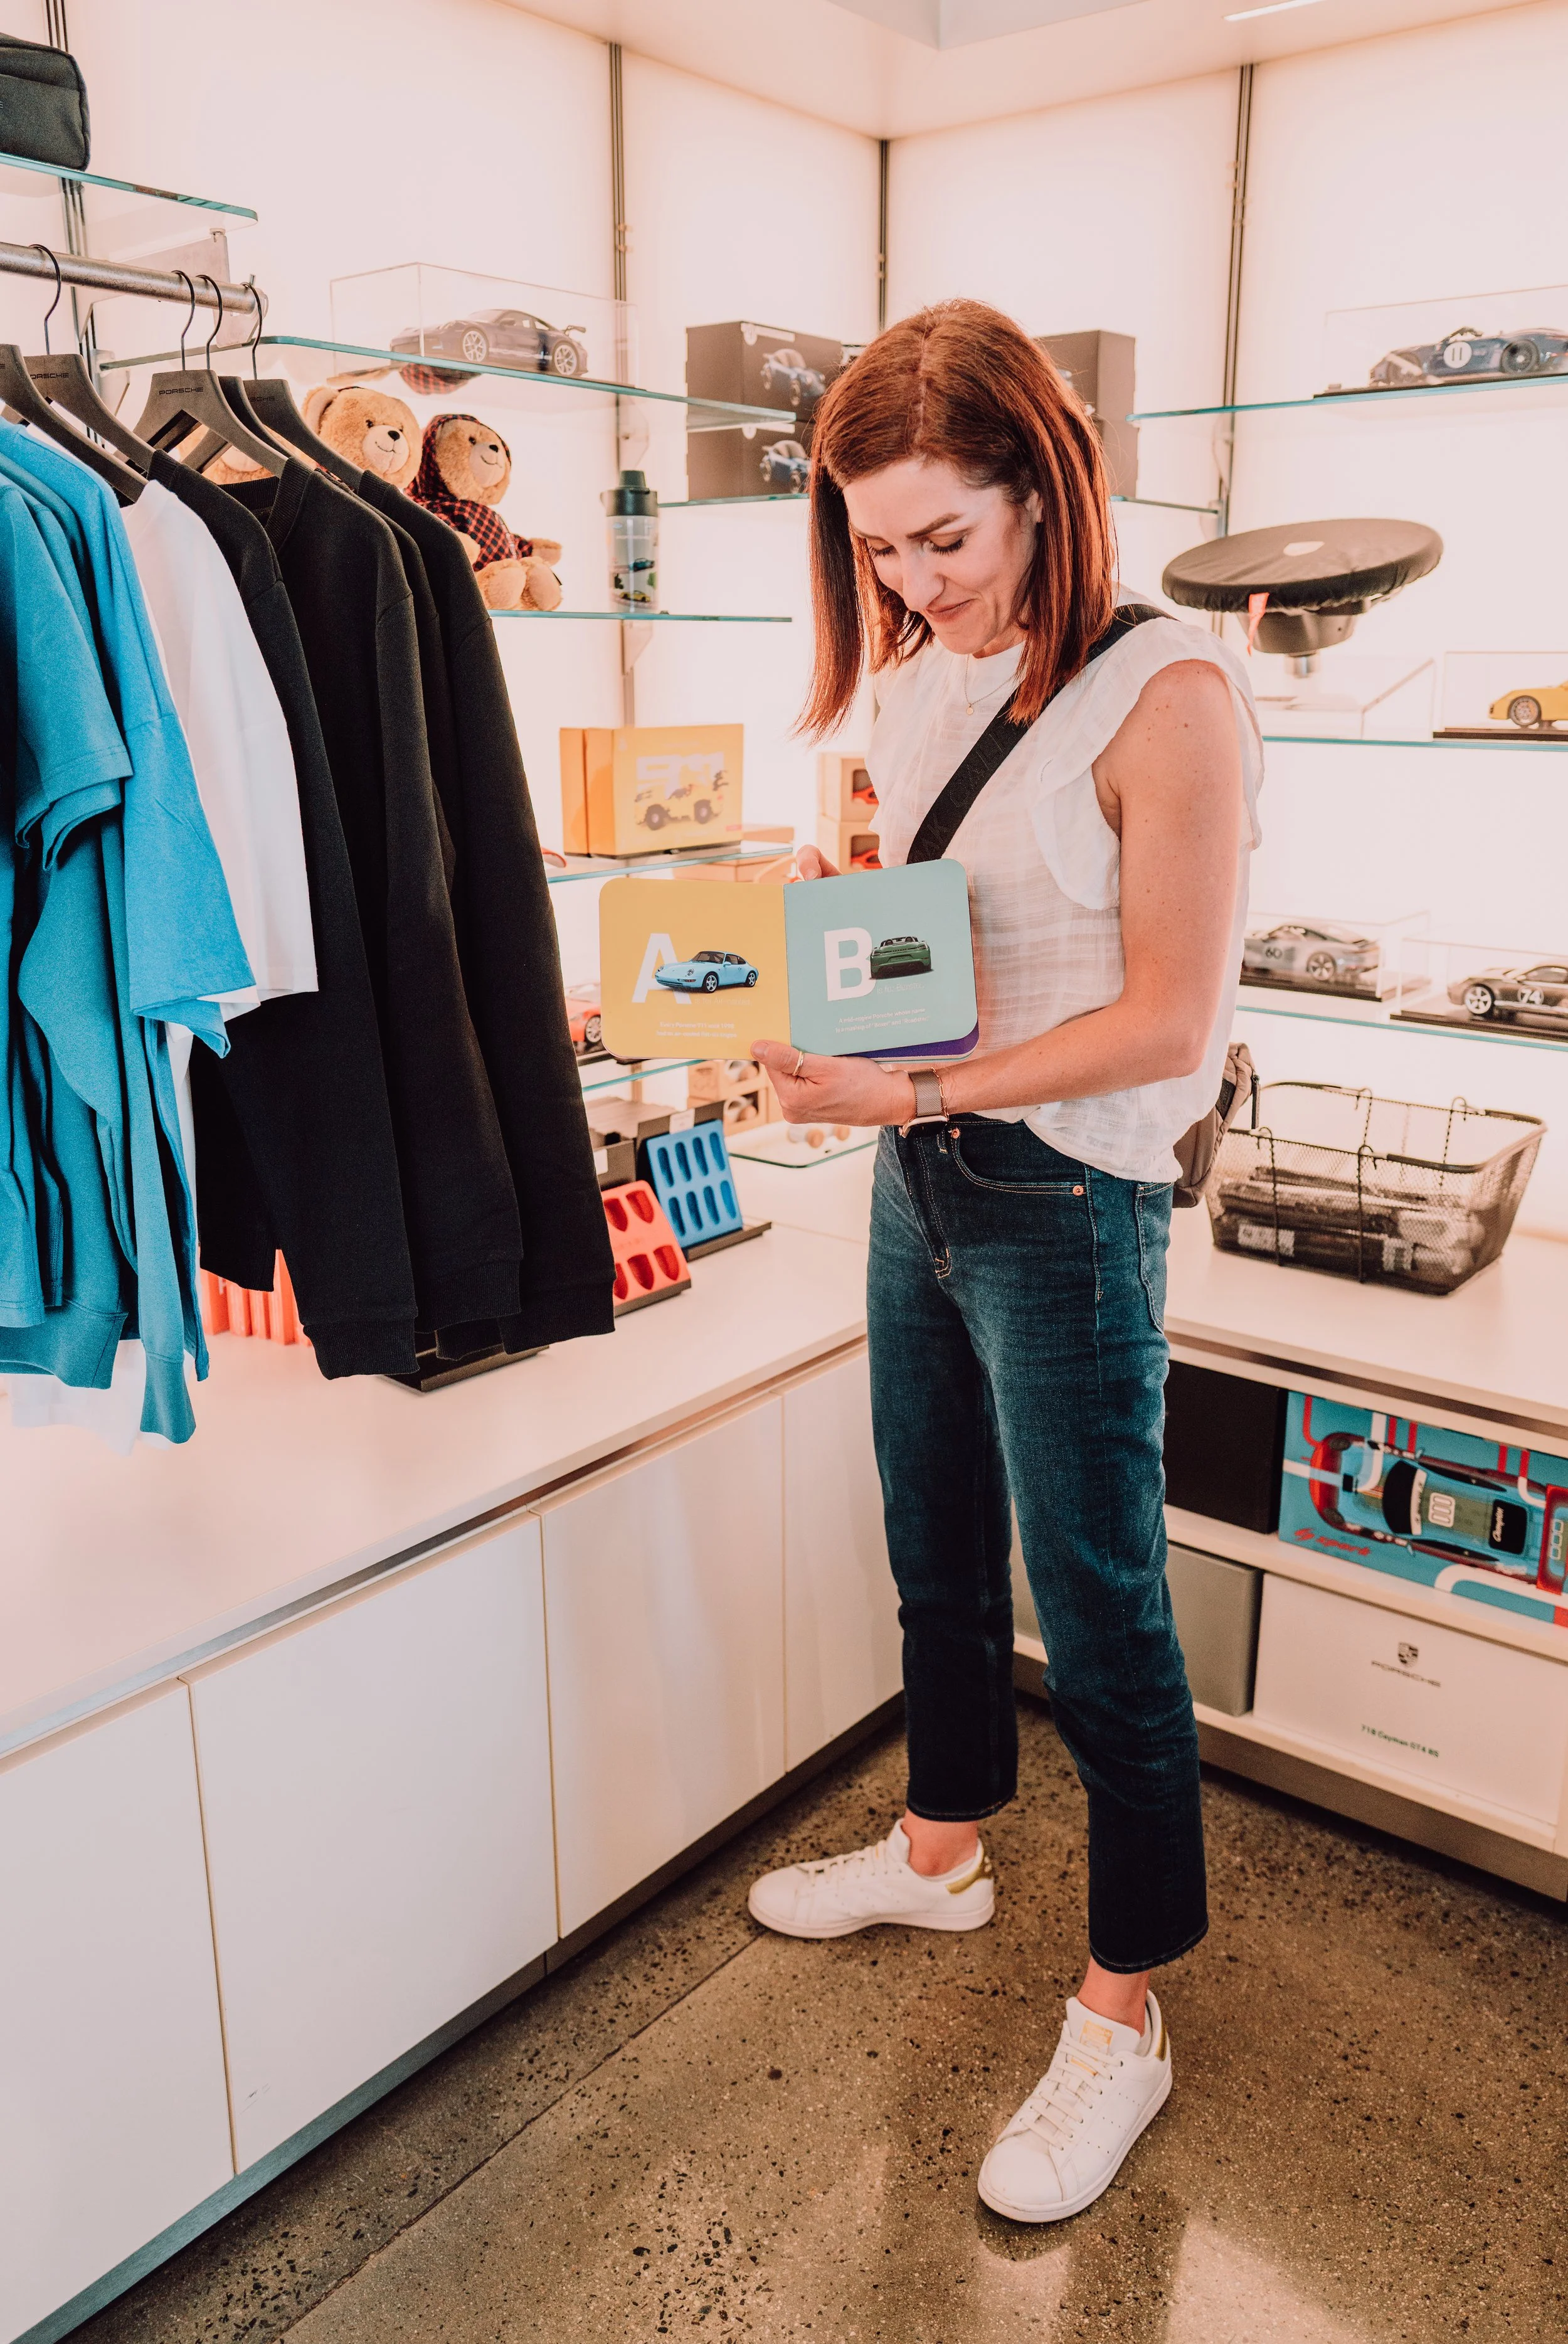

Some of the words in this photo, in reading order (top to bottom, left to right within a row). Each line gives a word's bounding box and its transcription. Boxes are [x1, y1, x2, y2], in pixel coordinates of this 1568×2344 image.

[159, 387, 204, 395] PORSCHE
[631, 933, 692, 1004] A
[824, 926, 877, 1002] B
[1520, 989, 1540, 1005] 74
[1492, 1506, 1505, 1542] Champion
[1371, 1661, 1441, 1687] PORSCHE
[1377, 1731, 1408, 1746] Cayman
